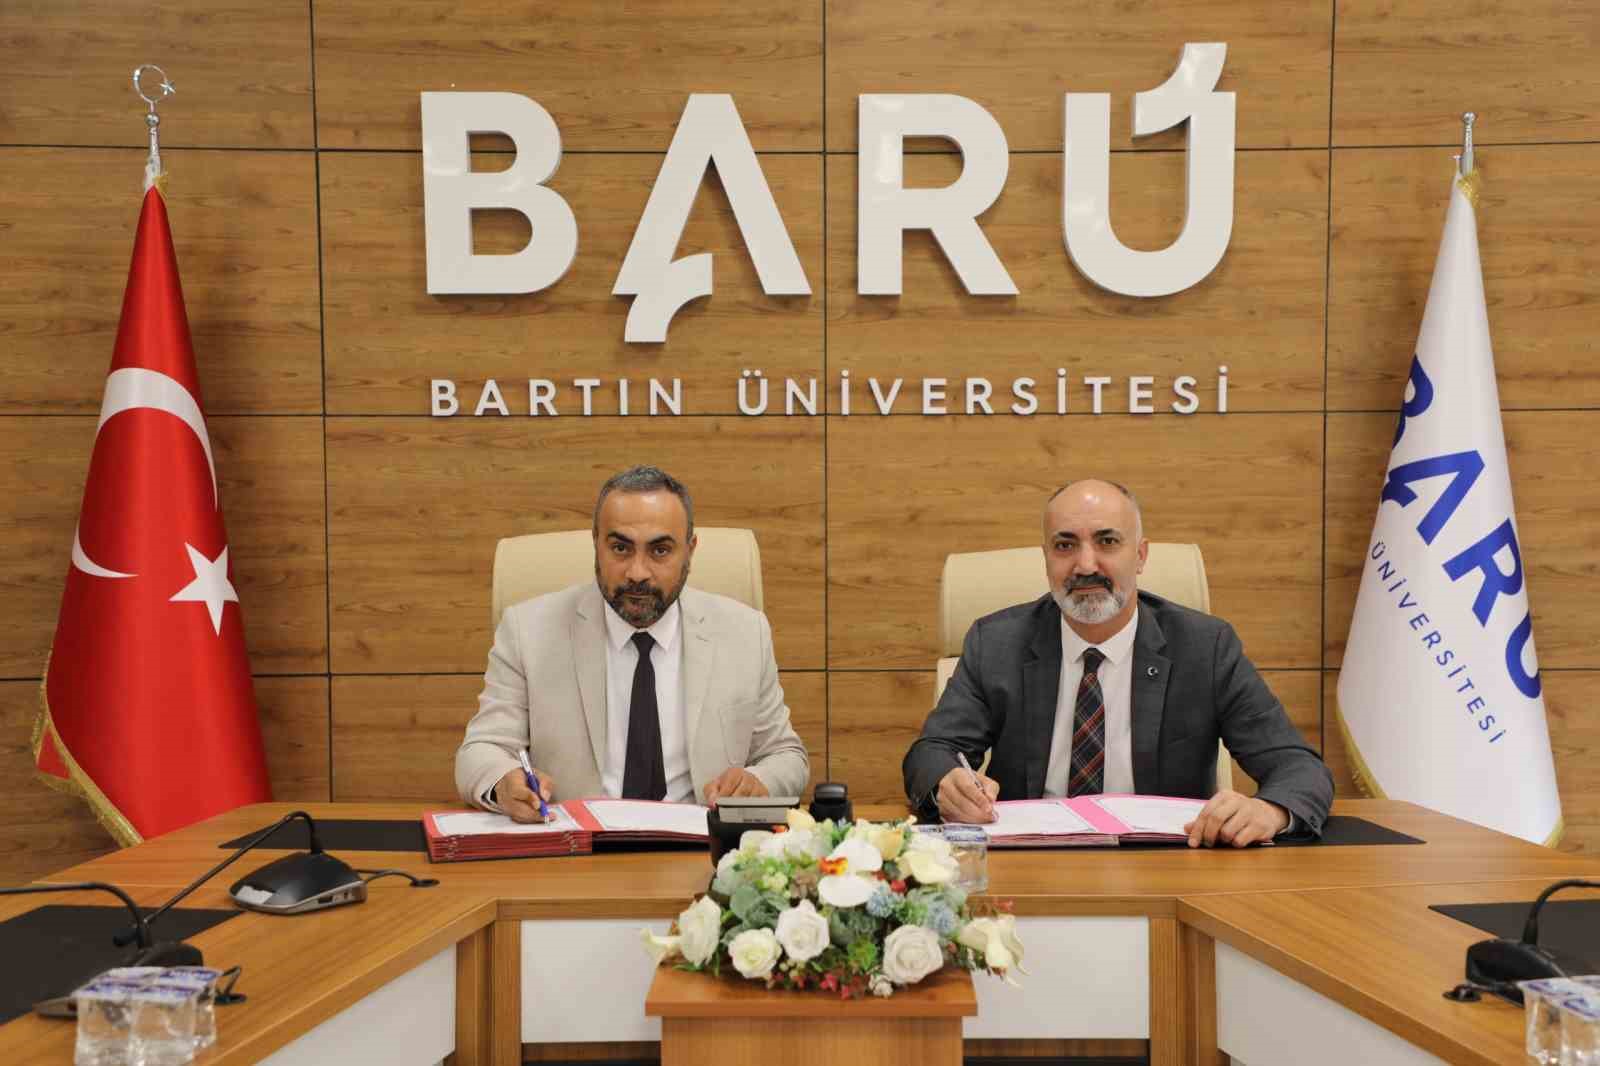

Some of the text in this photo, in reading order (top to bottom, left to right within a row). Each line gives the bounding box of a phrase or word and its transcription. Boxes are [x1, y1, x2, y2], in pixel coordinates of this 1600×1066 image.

[430, 365, 1230, 417] BARTIN ÜNİVERSİTESİ
[1371, 541, 1506, 744] ÜNİVERSİTESİ
